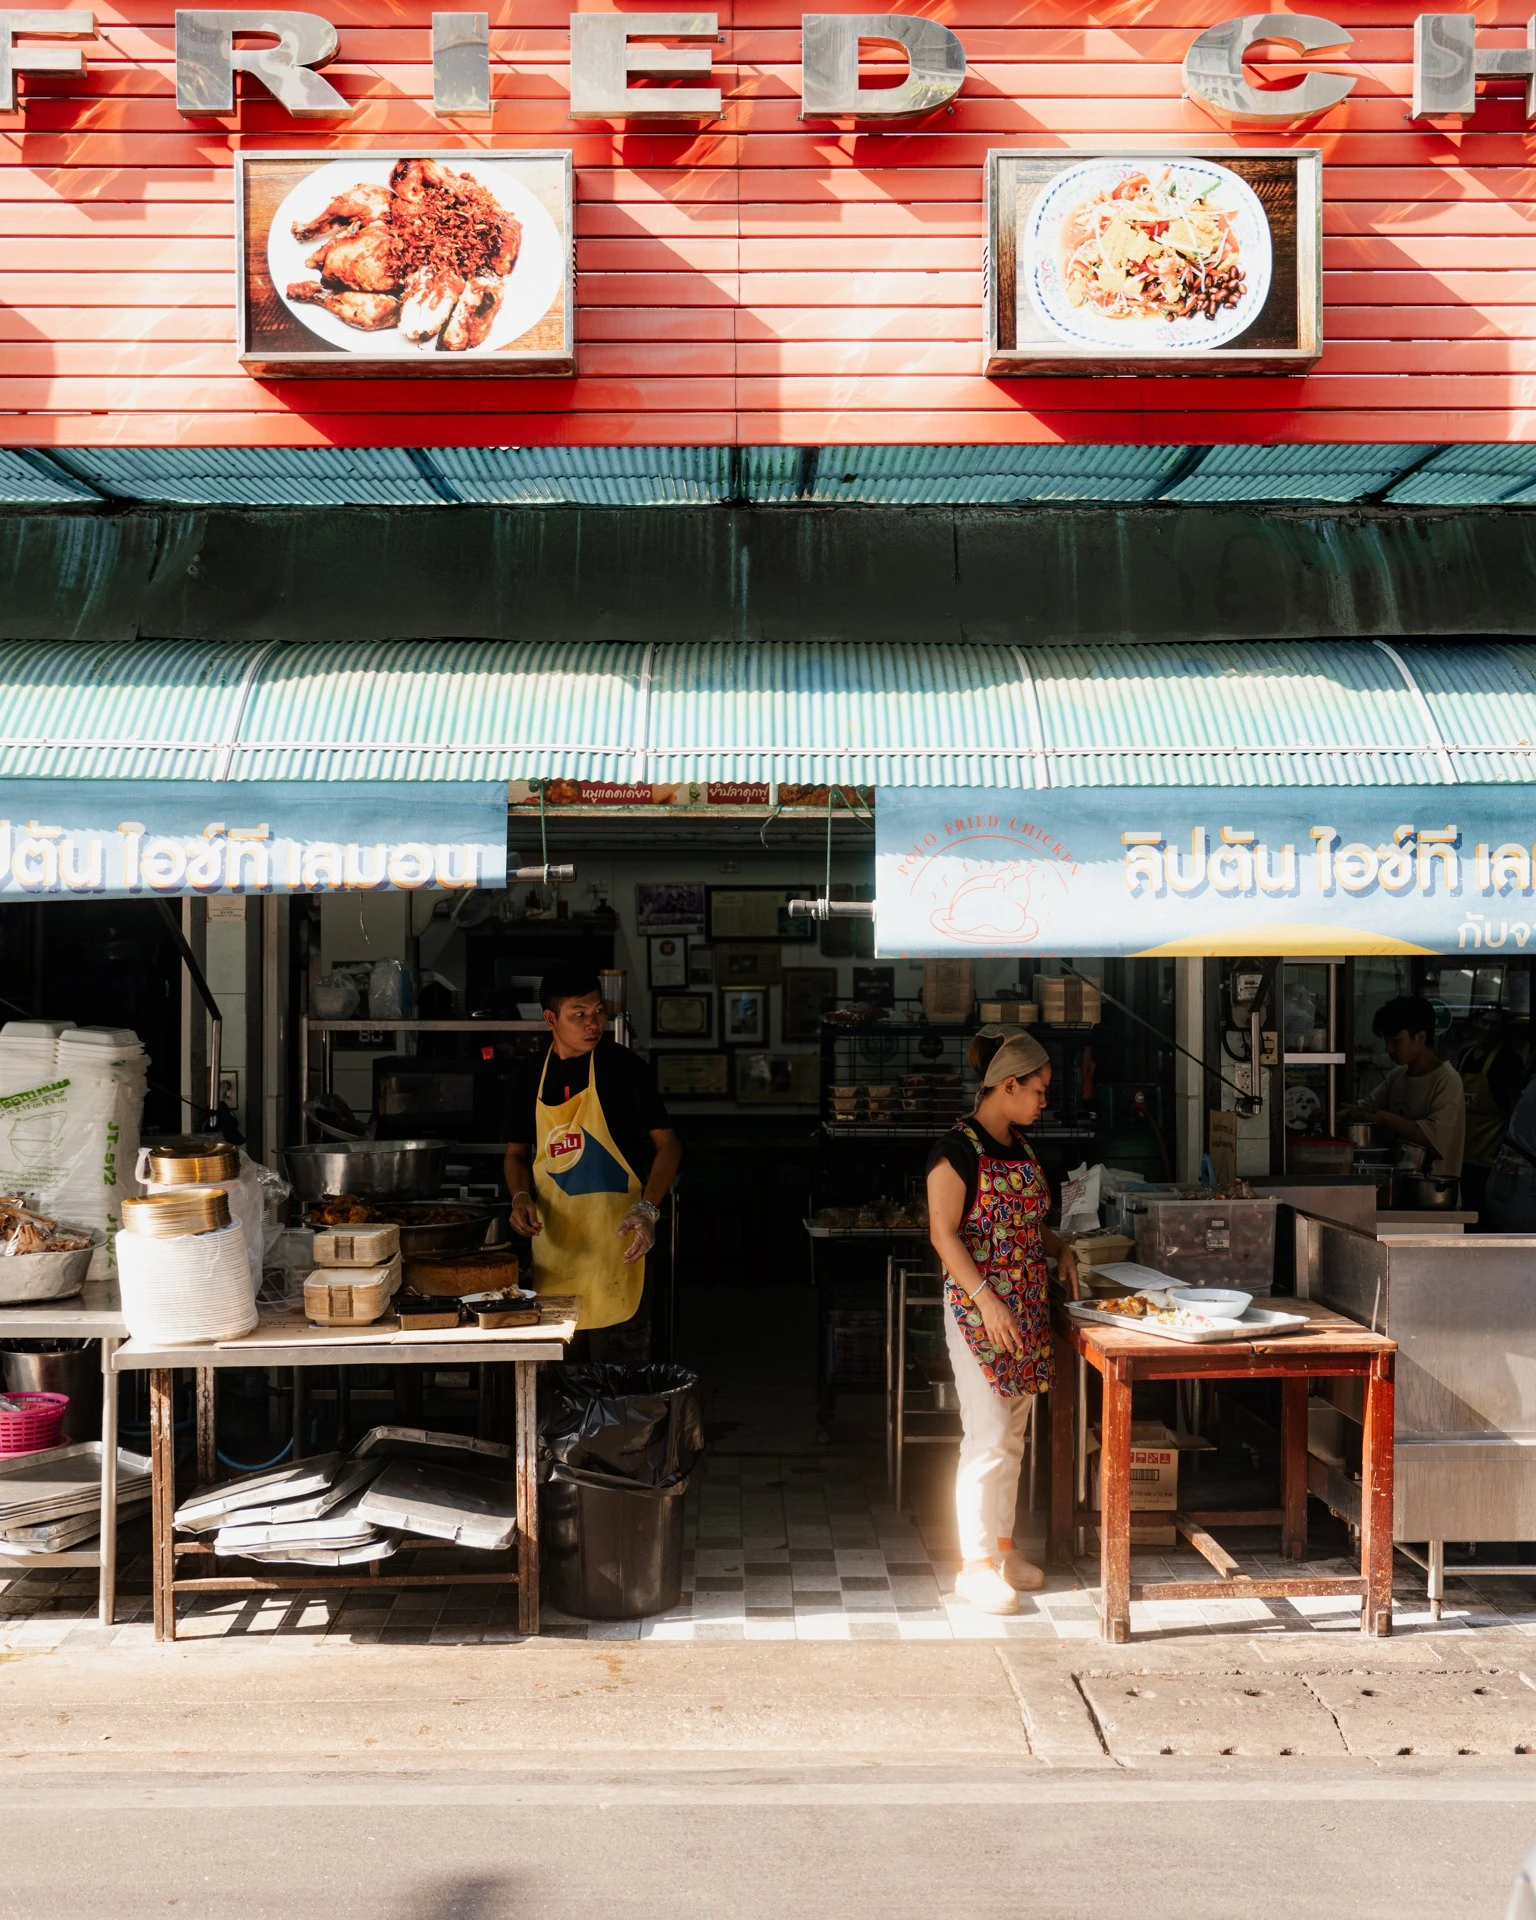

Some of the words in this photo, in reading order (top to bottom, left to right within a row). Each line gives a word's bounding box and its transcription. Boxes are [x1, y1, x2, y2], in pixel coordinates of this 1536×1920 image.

[0, 9, 966, 119] FRIED
[287, 842, 480, 890] เลมอน
[897, 833, 937, 876] POLO
[943, 815, 999, 835] FRIED
[1009, 818, 1081, 876] CHICKEN
[1121, 826, 1297, 895] ลิปตัน
[1475, 842, 1536, 892] เล
[1458, 911, 1536, 948] กับจ
